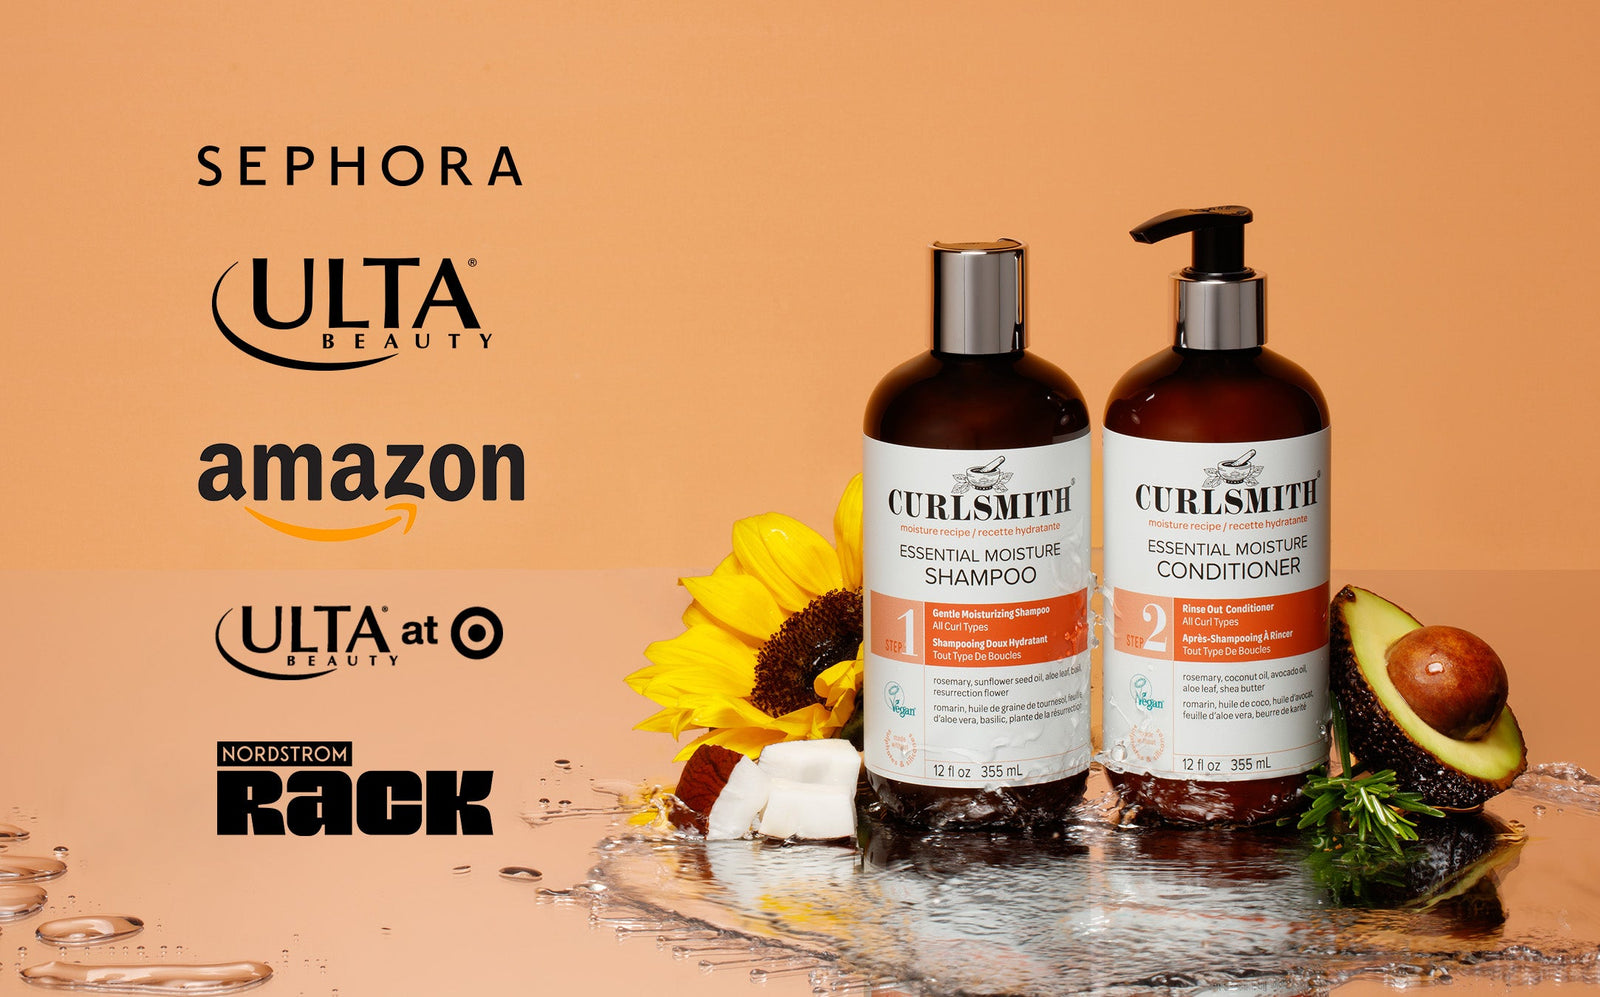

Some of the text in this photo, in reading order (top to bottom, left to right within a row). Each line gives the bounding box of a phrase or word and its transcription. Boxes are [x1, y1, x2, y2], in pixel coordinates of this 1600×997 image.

[888, 485, 1072, 521] CURLSMITH
[1135, 478, 1318, 515] CURLSMITH
[900, 524, 938, 536] moisture
[940, 527, 970, 538] recipe
[978, 527, 1014, 536] recette
[1015, 522, 1060, 536] hydratante
[1148, 519, 1188, 530] moisture
[1190, 522, 1222, 532] recipe
[1228, 520, 1264, 530] recette
[1265, 515, 1308, 530] hydratante
[900, 542, 1061, 562] ESSENTIAL MOISTURE
[1148, 535, 1308, 556] ESSENTIAL MOISTURE
[1157, 556, 1300, 580] CONDITIONER
[925, 566, 1036, 586] SHAMPOO
[932, 606, 1050, 620] Gentle Moisturizing Shampoo
[1182, 602, 1275, 614] Rinse Out Conditioner
[932, 622, 988, 632] All Curl Types
[1142, 603, 1167, 652] 2
[1182, 617, 1239, 628] All Curl Types
[897, 608, 918, 656] 1
[1182, 632, 1262, 645] Après-Shampooing
[1270, 630, 1293, 640] Rincer
[885, 639, 902, 654] STEP
[932, 635, 1048, 650] Shampooing Doux Hydratant
[1126, 634, 1144, 648] STEP
[933, 650, 1022, 662] Tout Type De Boucles
[1182, 645, 1271, 658] Tout Type De Boucles
[933, 677, 972, 687] rosemary,
[974, 677, 1013, 686] sunflower
[1015, 674, 1033, 684] seed
[1034, 673, 1044, 682] oil,
[1045, 671, 1059, 680] aloe
[1183, 674, 1222, 683] rosemary,
[1224, 673, 1257, 682] coconut
[1259, 671, 1269, 680] oil,
[1271, 667, 1298, 678] avocado
[933, 688, 1008, 697] resurrection flower
[1183, 684, 1265, 694] aloe leaf, shea butter
[889, 698, 916, 718] Vegan
[933, 704, 967, 713] romarin,
[968, 704, 988, 712] huile
[990, 704, 1000, 712] de
[1001, 703, 1025, 714] graine
[1027, 702, 1036, 710] de
[1136, 690, 1164, 711] Vegan
[1183, 700, 1216, 709] romarin,
[1218, 700, 1238, 708] huile
[1240, 700, 1250, 708] de
[1273, 696, 1289, 704] huile
[959, 716, 978, 725] vera,
[980, 714, 1008, 724] basilic,
[1009, 714, 1033, 724] plante
[1034, 712, 1043, 720] de
[1183, 711, 1207, 720] feuille
[1256, 710, 1280, 718] beurre
[934, 764, 1022, 778] 12 fl oz 355 mL
[1182, 757, 1271, 772] 12 fl oz 355 mL
